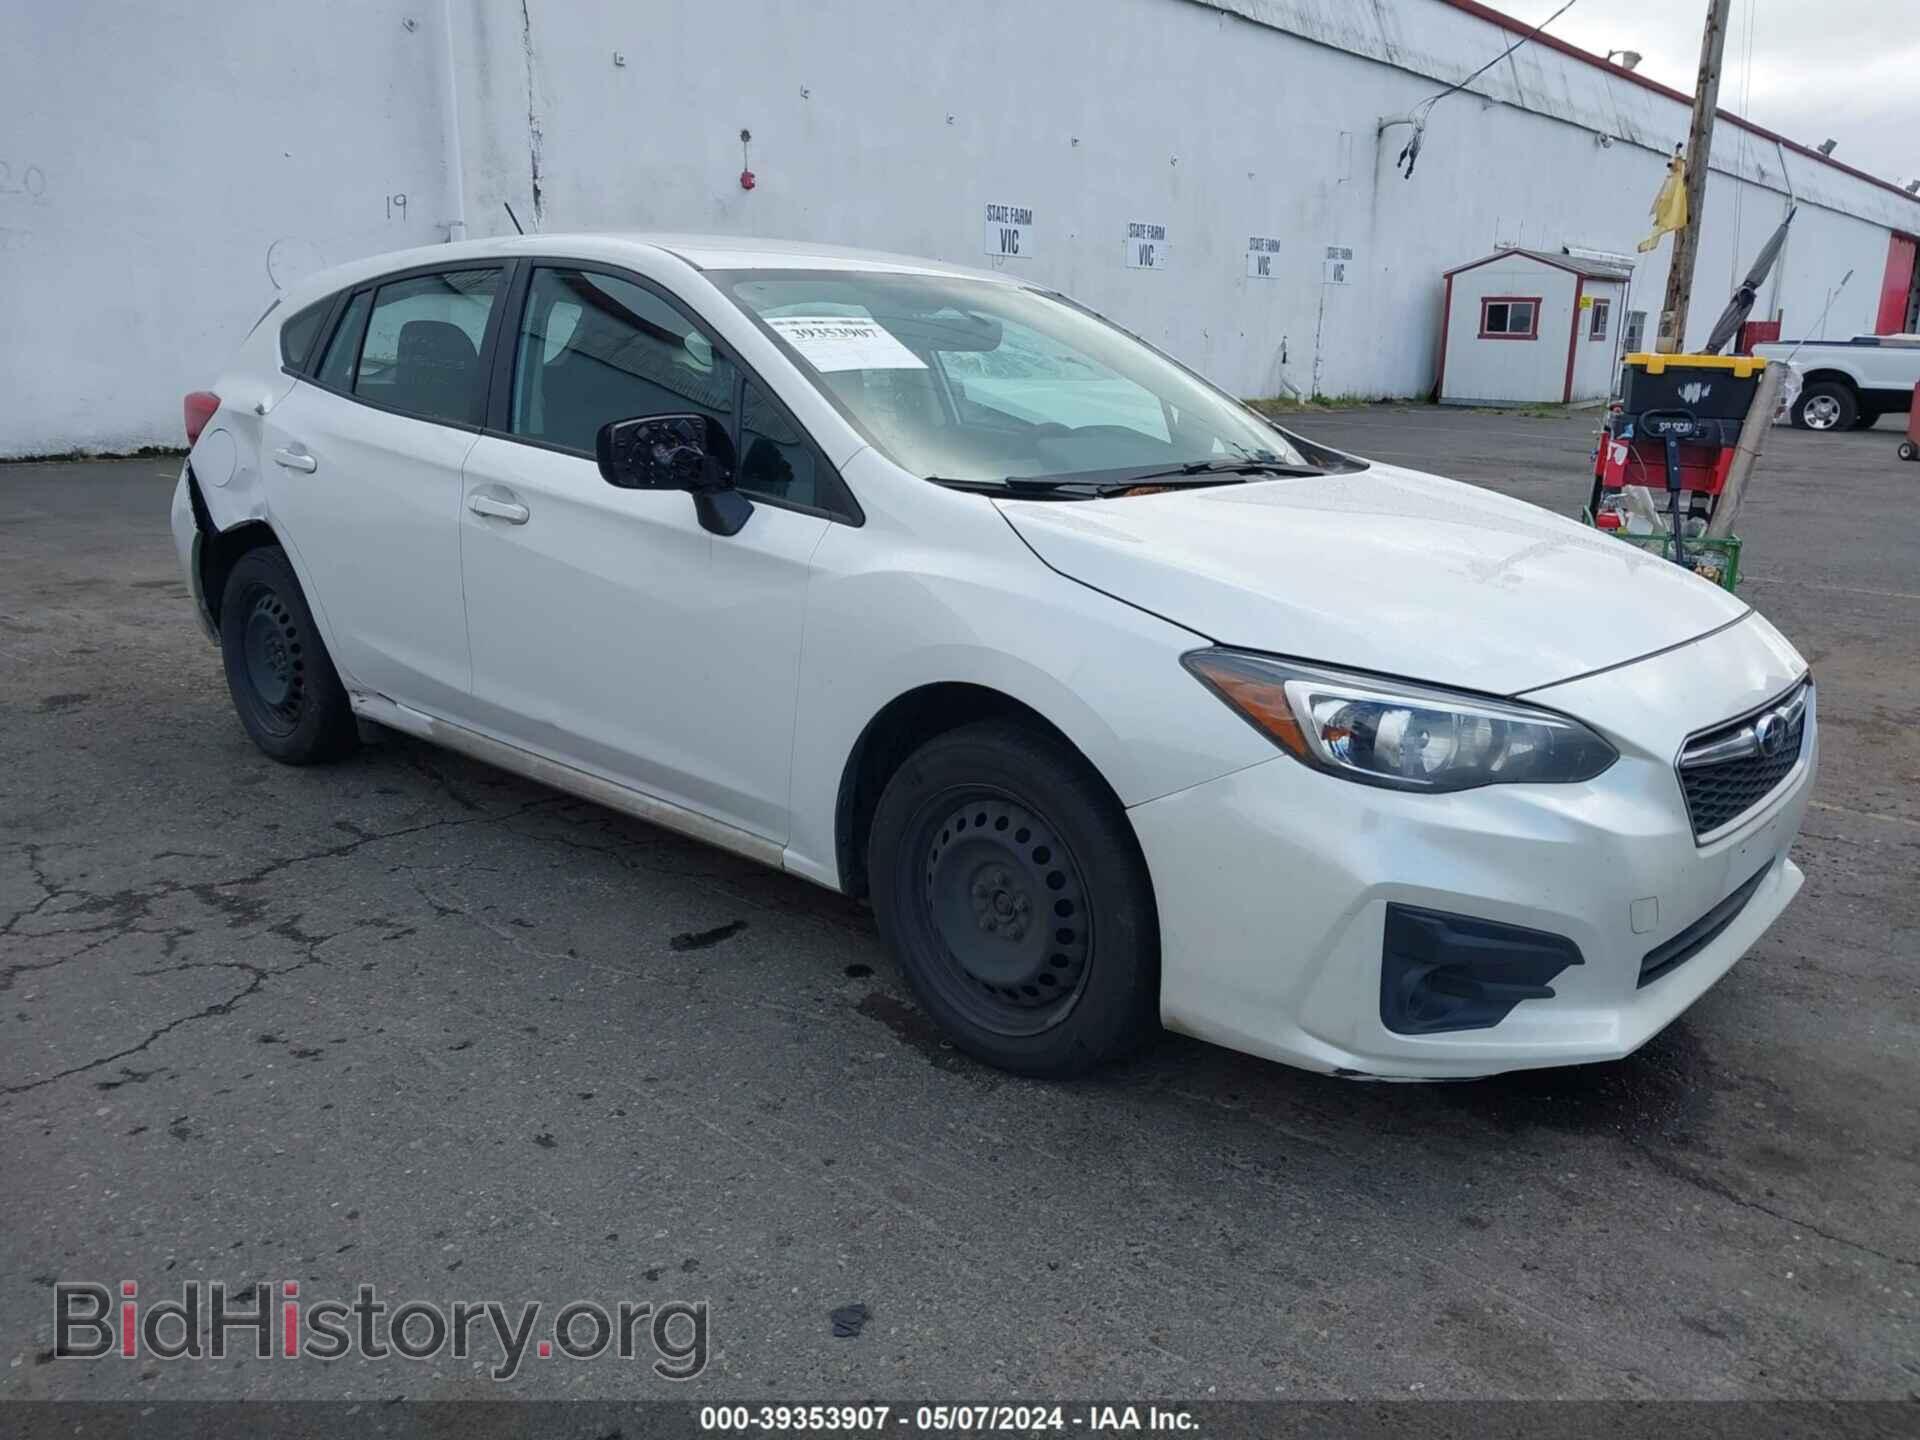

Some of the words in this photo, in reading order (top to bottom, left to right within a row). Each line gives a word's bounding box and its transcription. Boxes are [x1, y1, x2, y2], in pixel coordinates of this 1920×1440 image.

[386, 193, 407, 222] 19
[987, 204, 1008, 223] STATE
[1010, 207, 1032, 225] FARM
[1000, 228, 1019, 254] VIC
[1129, 222, 1145, 239] STATE
[1147, 224, 1165, 240] FARM
[1139, 243, 1154, 266] VIC
[1257, 255, 1271, 275] VIC
